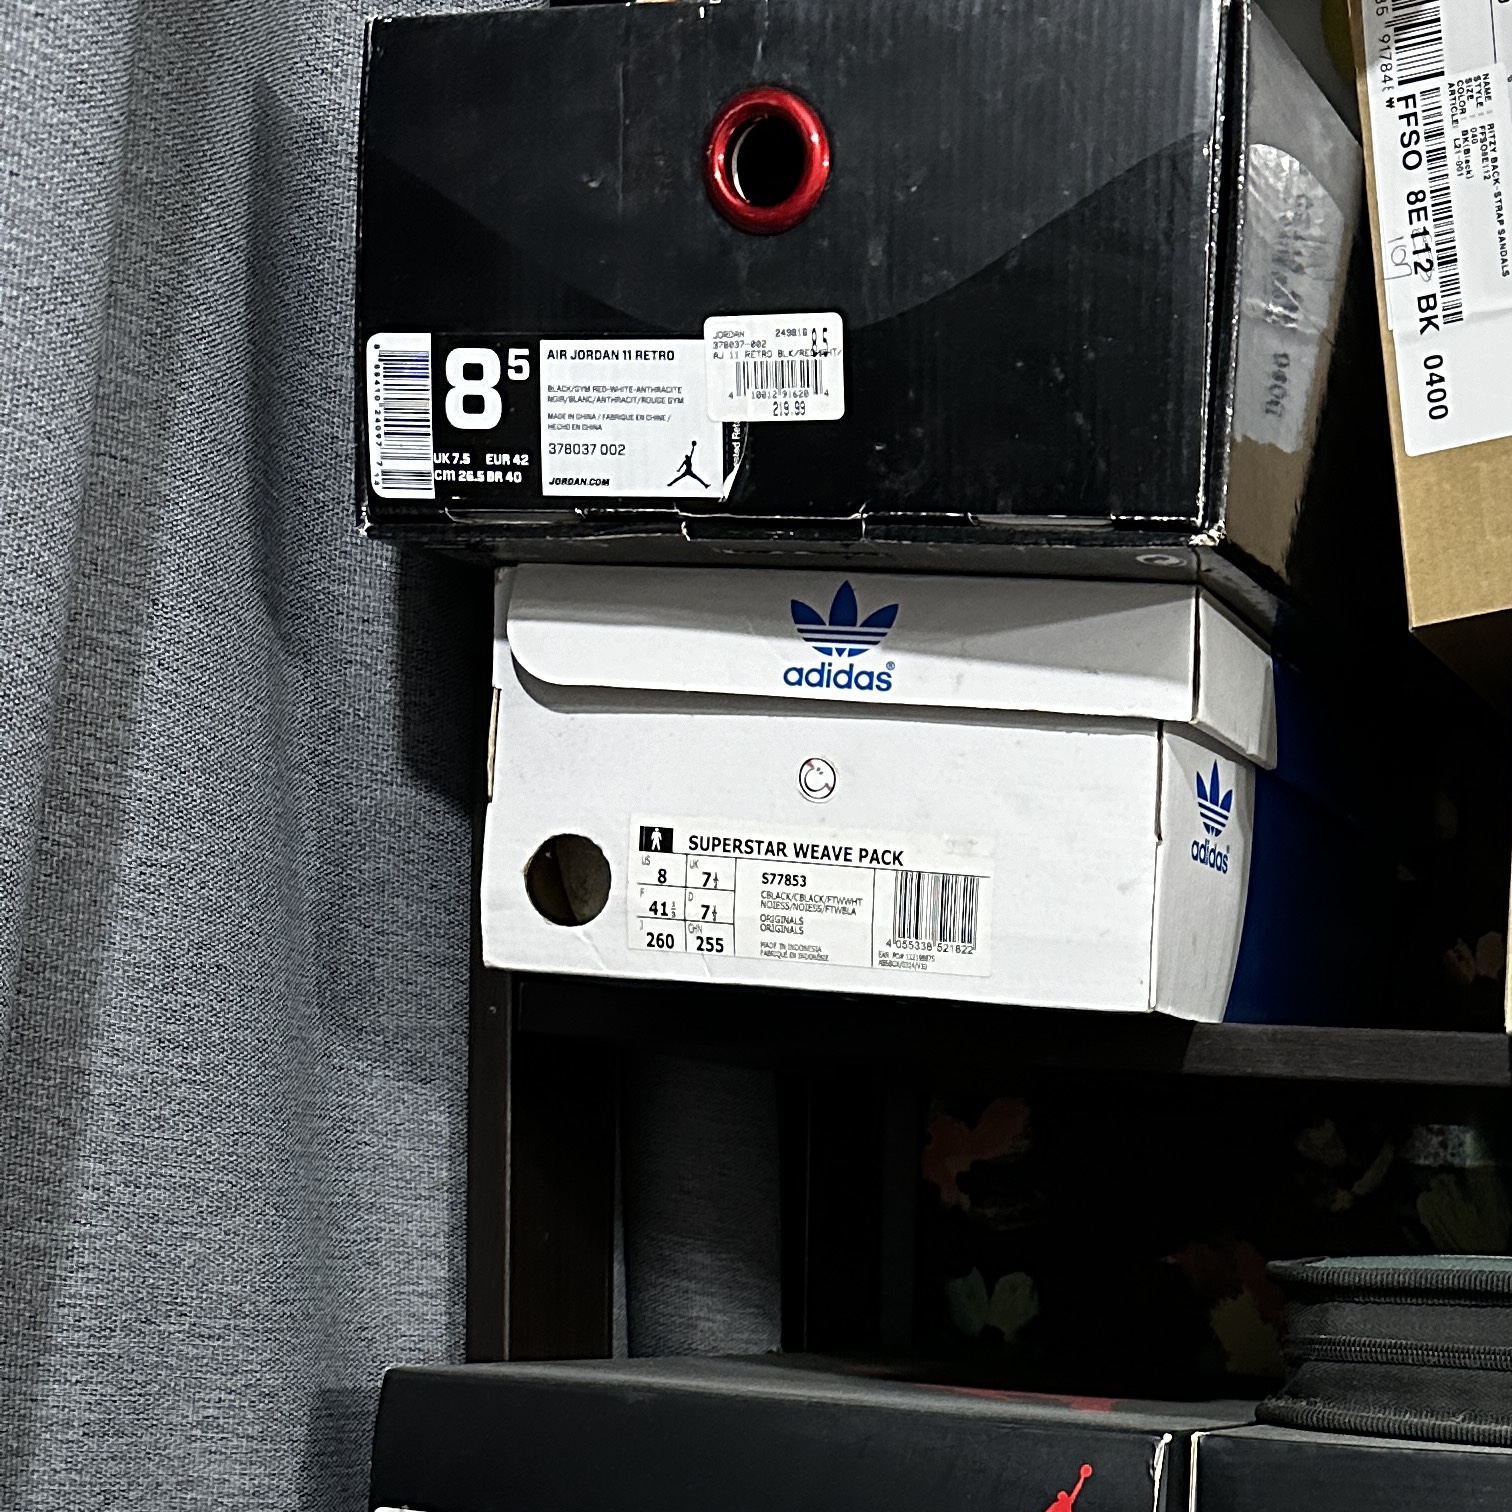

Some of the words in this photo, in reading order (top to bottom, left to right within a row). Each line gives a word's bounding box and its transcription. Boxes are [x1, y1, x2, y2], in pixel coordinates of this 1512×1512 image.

[1397, 94, 1423, 171] FFSO
[1407, 189, 1434, 275] 8E112
[1498, 229, 1510, 277] SANDALS
[1417, 294, 1440, 334] BK
[547, 350, 567, 360] AIR
[570, 350, 619, 360] JORDAN
[623, 350, 631, 360] 11
[635, 350, 674, 361] RETRO
[445, 348, 502, 429] 8
[508, 348, 530, 380] 5
[1424, 354, 1448, 421] 0400
[433, 453, 450, 464] UK
[452, 453, 470, 464] 7.5
[486, 454, 511, 465] EUR
[513, 454, 529, 465] 42
[549, 443, 596, 455] 378037
[600, 444, 625, 456] 002
[505, 471, 522, 483] 40
[549, 477, 610, 486] JORDAN.COM
[783, 662, 893, 692] adidas
[688, 834, 788, 858] SUPERSTAR
[794, 842, 853, 862] WEAVE
[859, 848, 904, 866] PACK
[1191, 837, 1229, 874] adidas
[658, 868, 667, 884] 8
[762, 872, 806, 887] S77853
[760, 923, 804, 935] ORIGINALS
[646, 932, 674, 949] 260
[696, 936, 724, 953] 255
